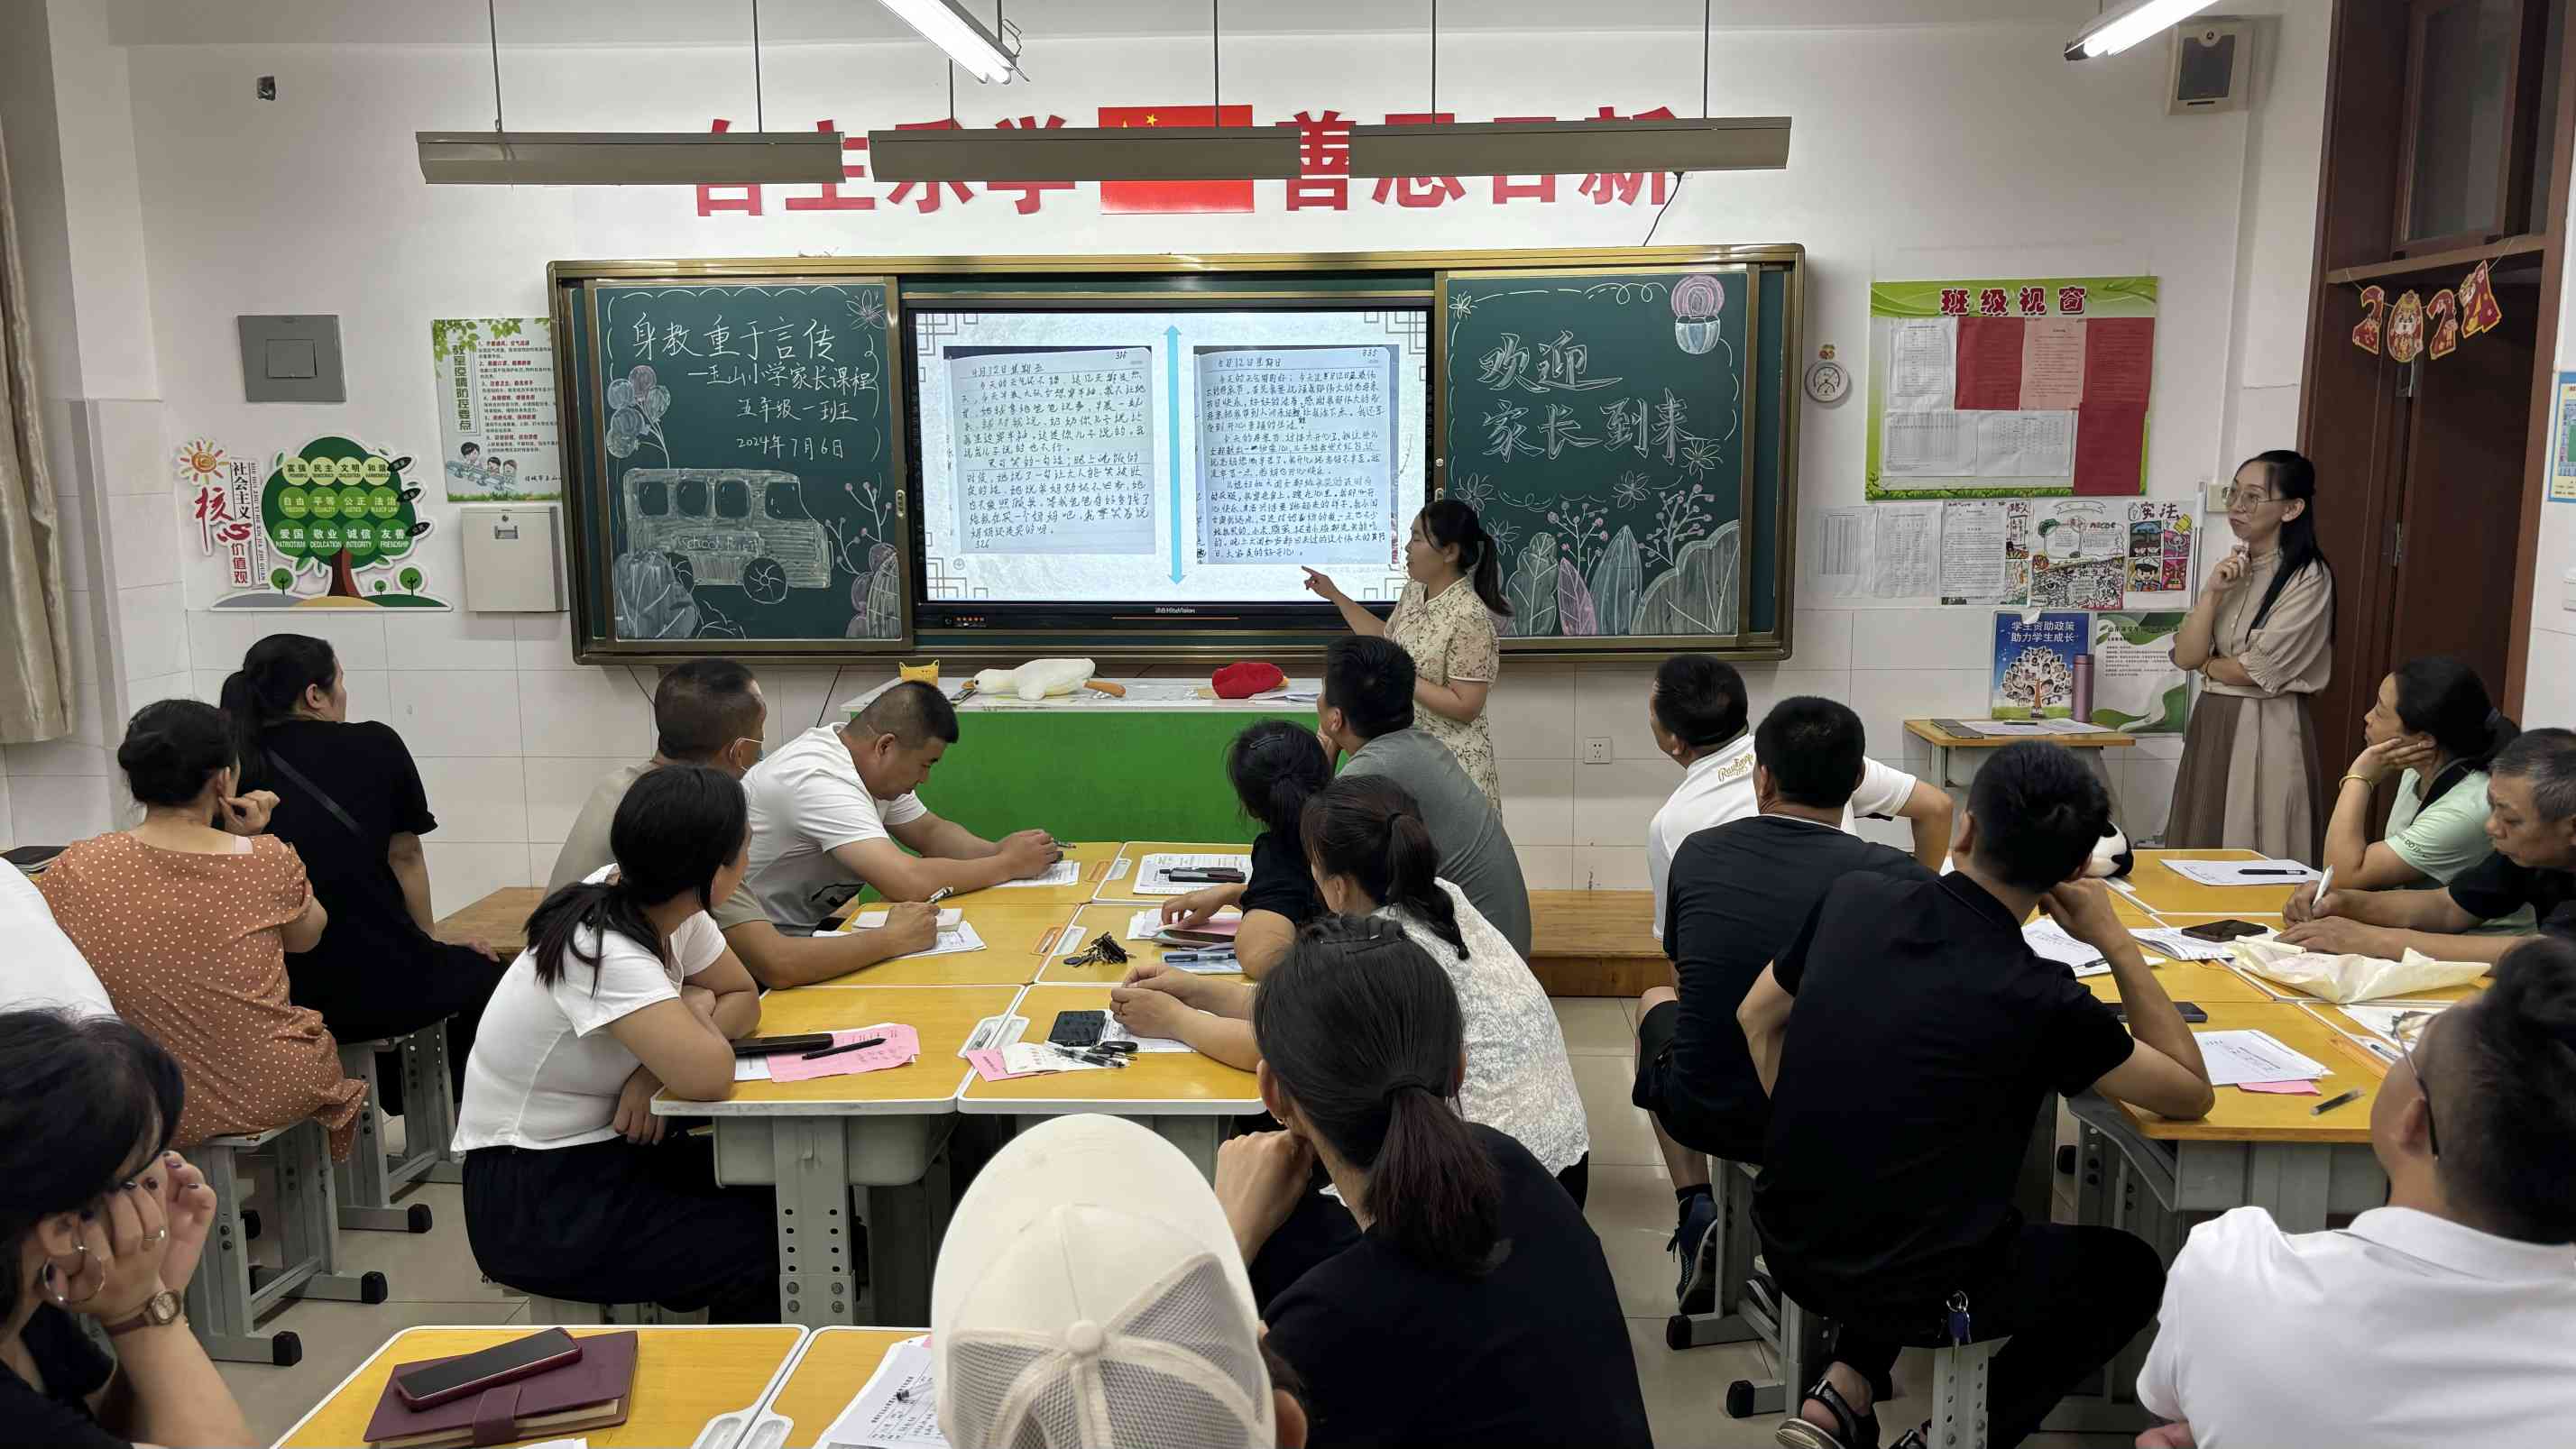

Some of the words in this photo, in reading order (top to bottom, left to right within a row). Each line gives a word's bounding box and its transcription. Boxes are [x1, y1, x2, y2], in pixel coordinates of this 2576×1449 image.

[1941, 287, 2085, 315] 班级视窗
[633, 312, 836, 362] 身教重于言传
[1477, 330, 1623, 393] 欢迎
[736, 398, 859, 422] 五年级一班
[1482, 387, 1719, 465] 家长到来
[287, 463, 307, 472] 富强
[314, 463, 333, 472] 民主
[341, 463, 360, 472] 文明
[233, 462, 252, 519] 社会主义
[283, 497, 305, 506] 自由
[314, 497, 336, 506] 平等
[344, 497, 366, 506] 公正
[374, 497, 397, 506] 法治
[195, 487, 253, 552] 核心
[2140, 501, 2180, 520] 宪法
[280, 529, 304, 539] 爱国
[314, 529, 338, 539] 敬业
[346, 529, 372, 539] 诚信
[381, 529, 406, 539] 友善
[232, 543, 248, 583] 价值观
[2010, 632, 2075, 643] 助力学生成长
[2011, 620, 2075, 631] 学生资助政策
